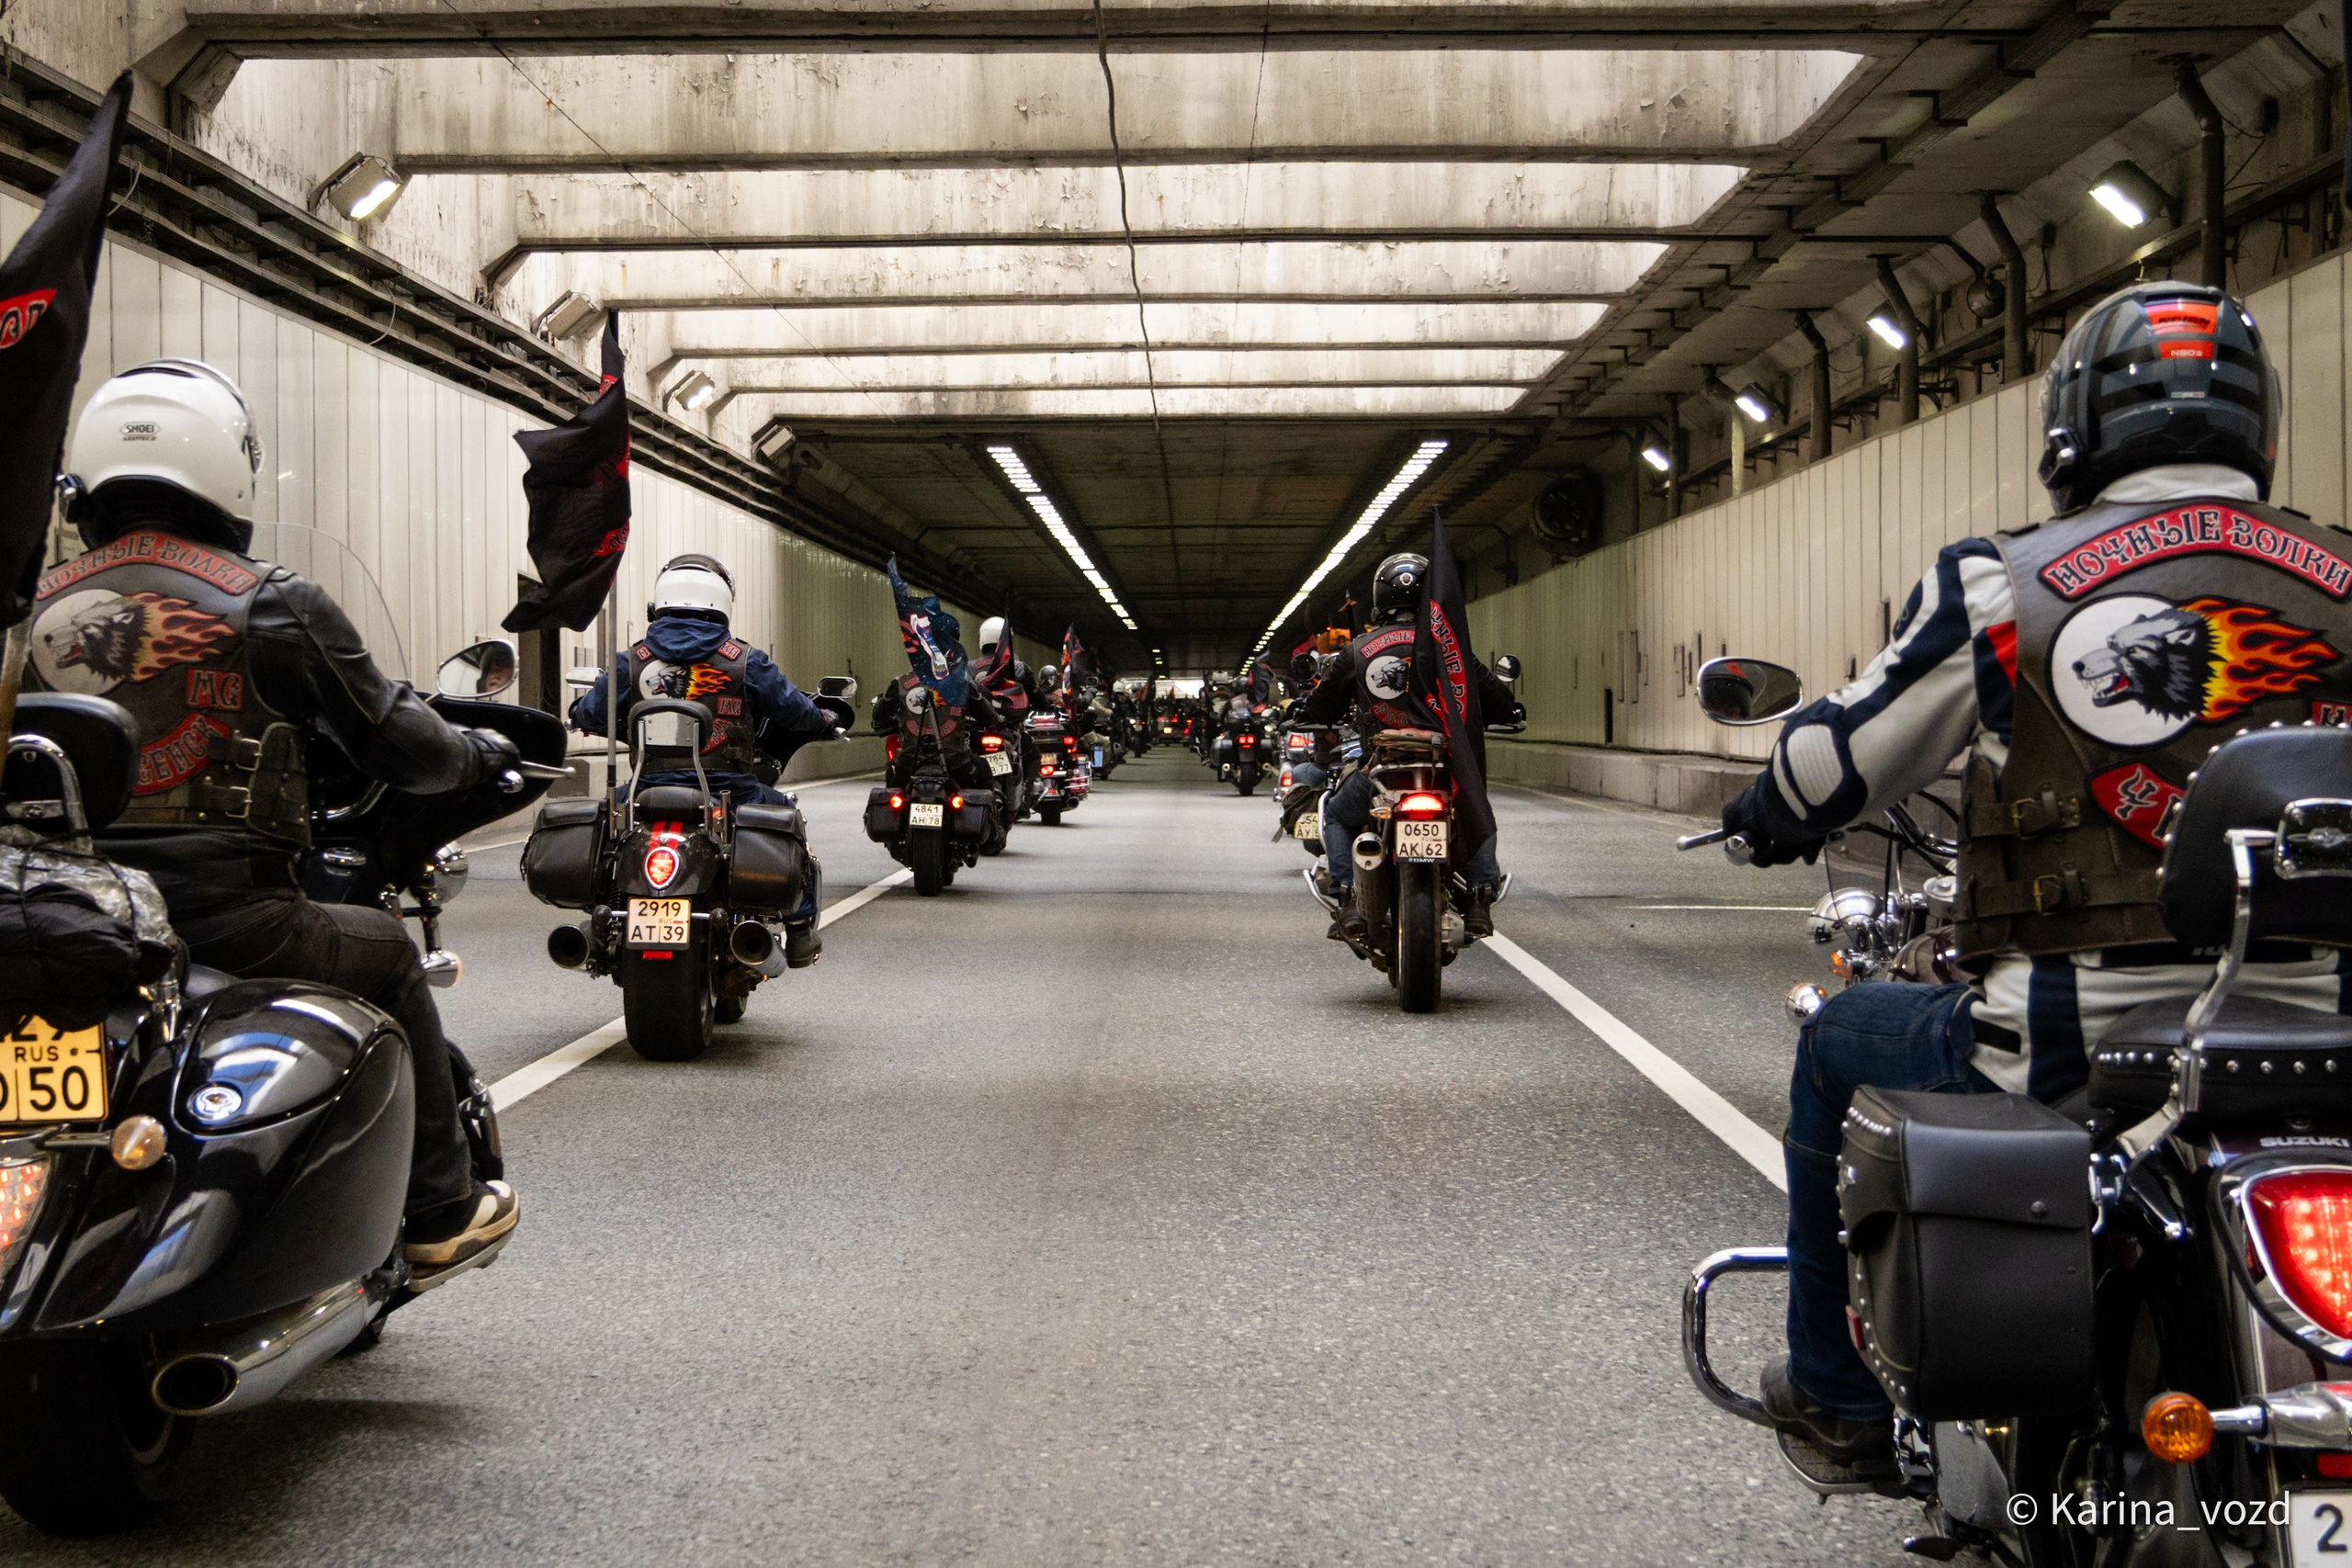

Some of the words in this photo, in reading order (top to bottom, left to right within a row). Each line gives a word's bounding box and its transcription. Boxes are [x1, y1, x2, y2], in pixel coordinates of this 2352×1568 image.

[125, 424, 154, 434] SHOEI
[2045, 510, 2222, 595] НОЧНЫЕ
[2227, 514, 2352, 593] ВОЛКИ
[1363, 631, 1411, 657] НОЧНЫЕ
[915, 805, 939, 814] 4841
[928, 817, 940, 825] 78
[1404, 823, 1440, 836] 0650
[1426, 843, 1442, 856] 62
[638, 901, 682, 917] 2919
[663, 926, 684, 941] 39
[15, 1046, 59, 1063] RUS
[29, 1066, 89, 1111] 50
[2259, 1136, 2350, 1148] SUZUKI
